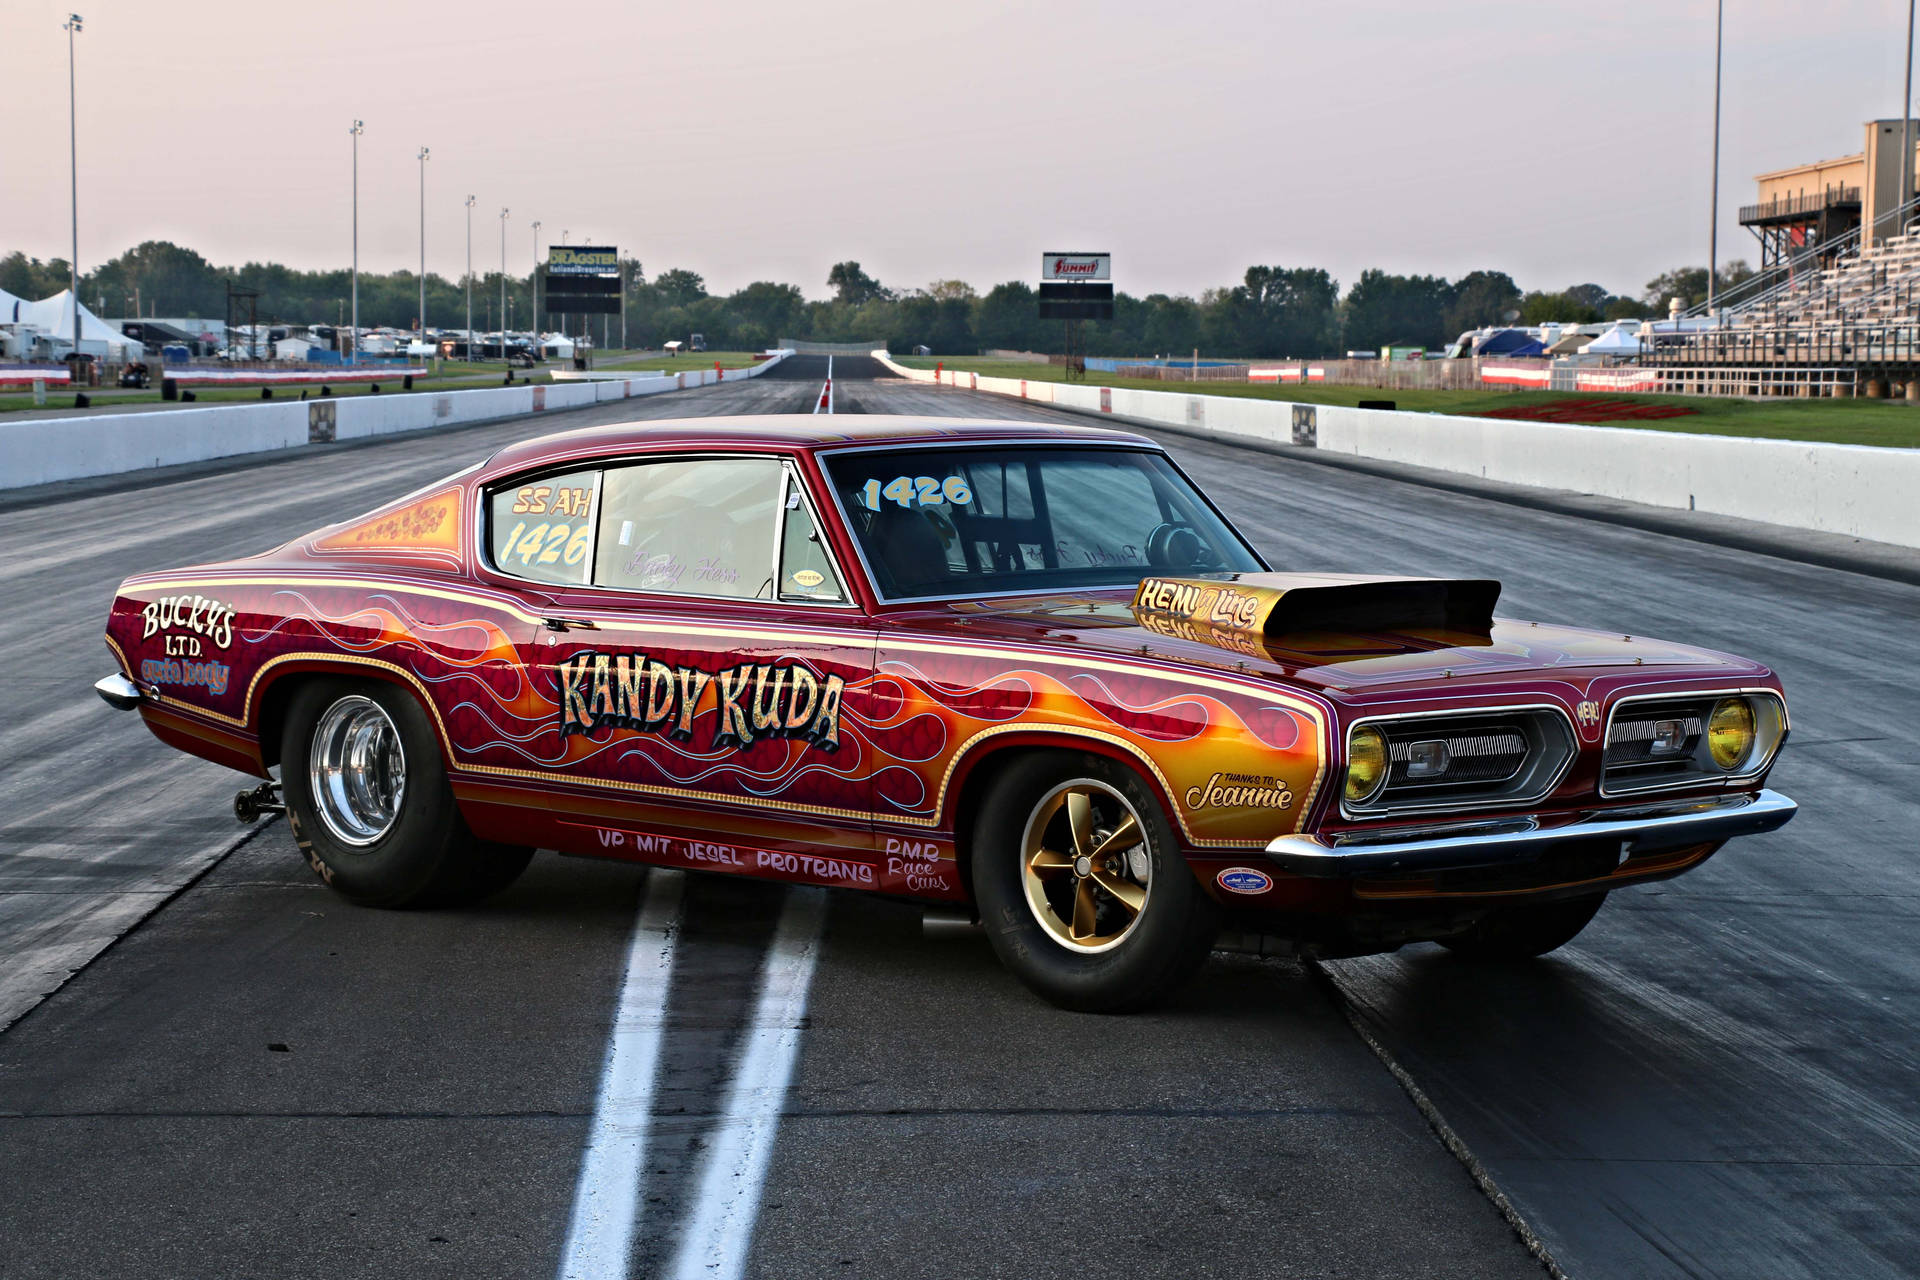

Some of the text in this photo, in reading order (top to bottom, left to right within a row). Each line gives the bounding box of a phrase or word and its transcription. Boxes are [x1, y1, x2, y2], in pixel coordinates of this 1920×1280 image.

[550, 253, 617, 265] DRAGSTER
[863, 476, 973, 512] 1426
[500, 520, 590, 567] 1426
[1139, 579, 1201, 617] HEMI
[1210, 588, 1258, 629] Line
[165, 635, 204, 657] LTD.
[141, 658, 231, 696] auto body
[558, 653, 846, 748] KANDY KUDA
[1185, 772, 1293, 810] Jeannie
[1224, 773, 1274, 785] THANKS TO
[597, 829, 625, 848] VP
[683, 842, 744, 866] JESEL
[887, 857, 936, 877] Race
[906, 874, 950, 892] Cars
